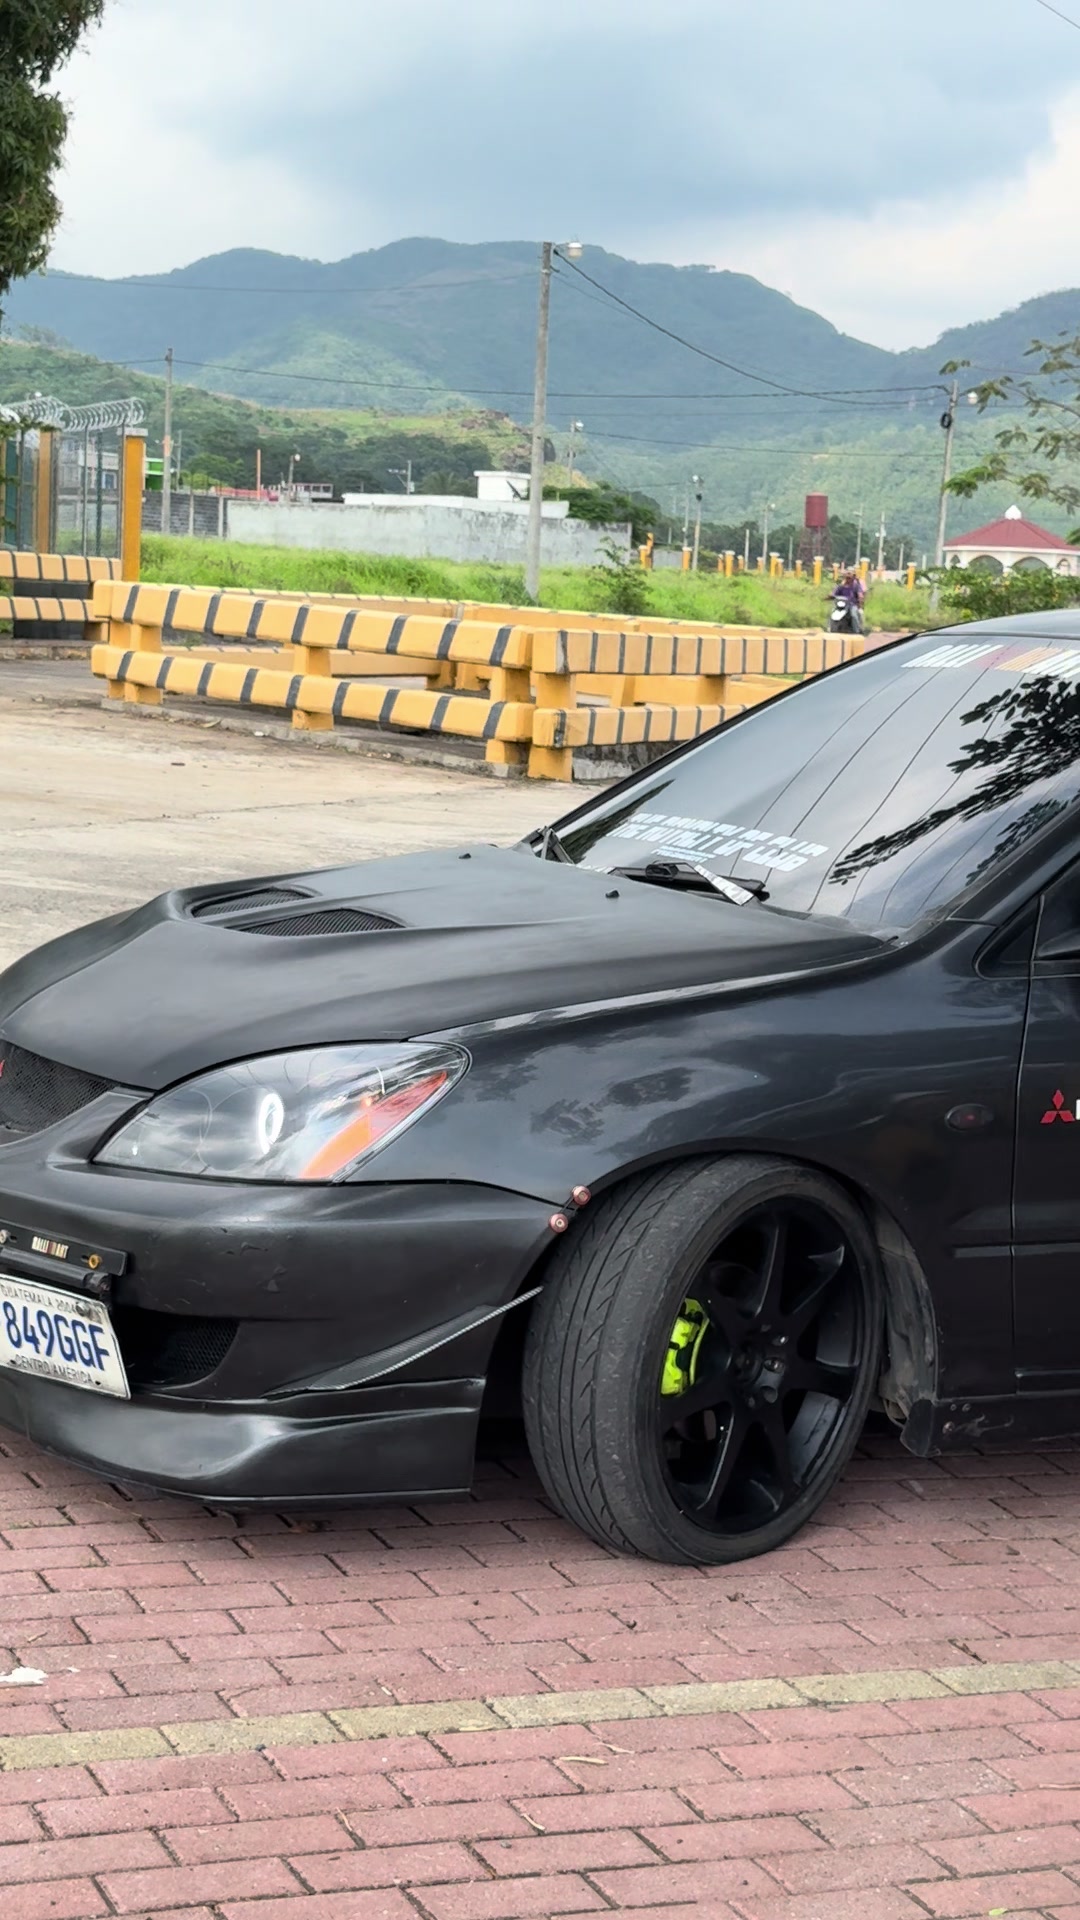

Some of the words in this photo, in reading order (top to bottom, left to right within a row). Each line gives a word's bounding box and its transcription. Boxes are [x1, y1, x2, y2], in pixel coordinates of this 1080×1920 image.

[0, 1284, 53, 1307] GUATEMALA
[2, 1301, 109, 1371] 849GGF
[14, 1354, 51, 1374] CENTRO
